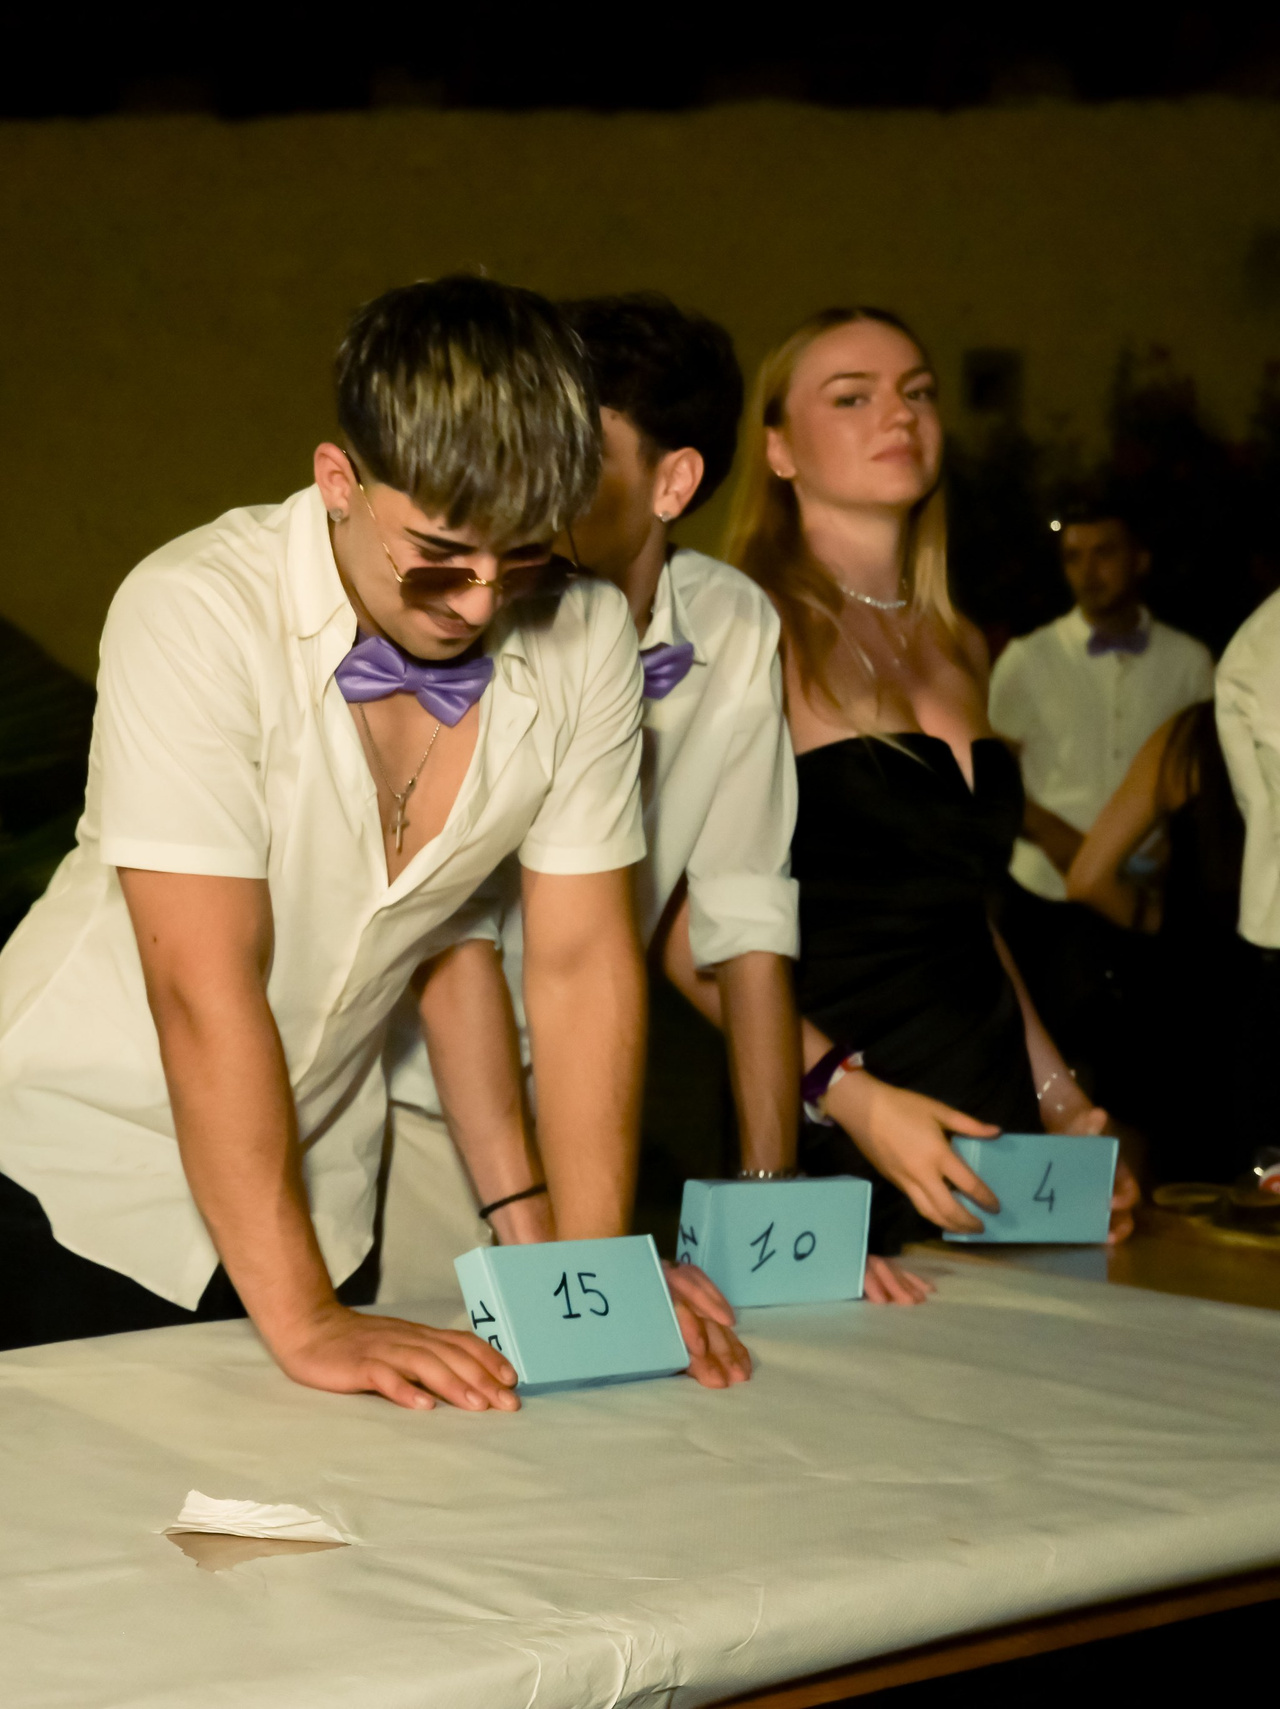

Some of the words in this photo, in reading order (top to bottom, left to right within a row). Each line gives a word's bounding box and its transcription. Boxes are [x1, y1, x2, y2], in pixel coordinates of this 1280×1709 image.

[1033, 1160, 1055, 1213] 4
[750, 1221, 816, 1273] 10
[553, 1271, 609, 1319] 15
